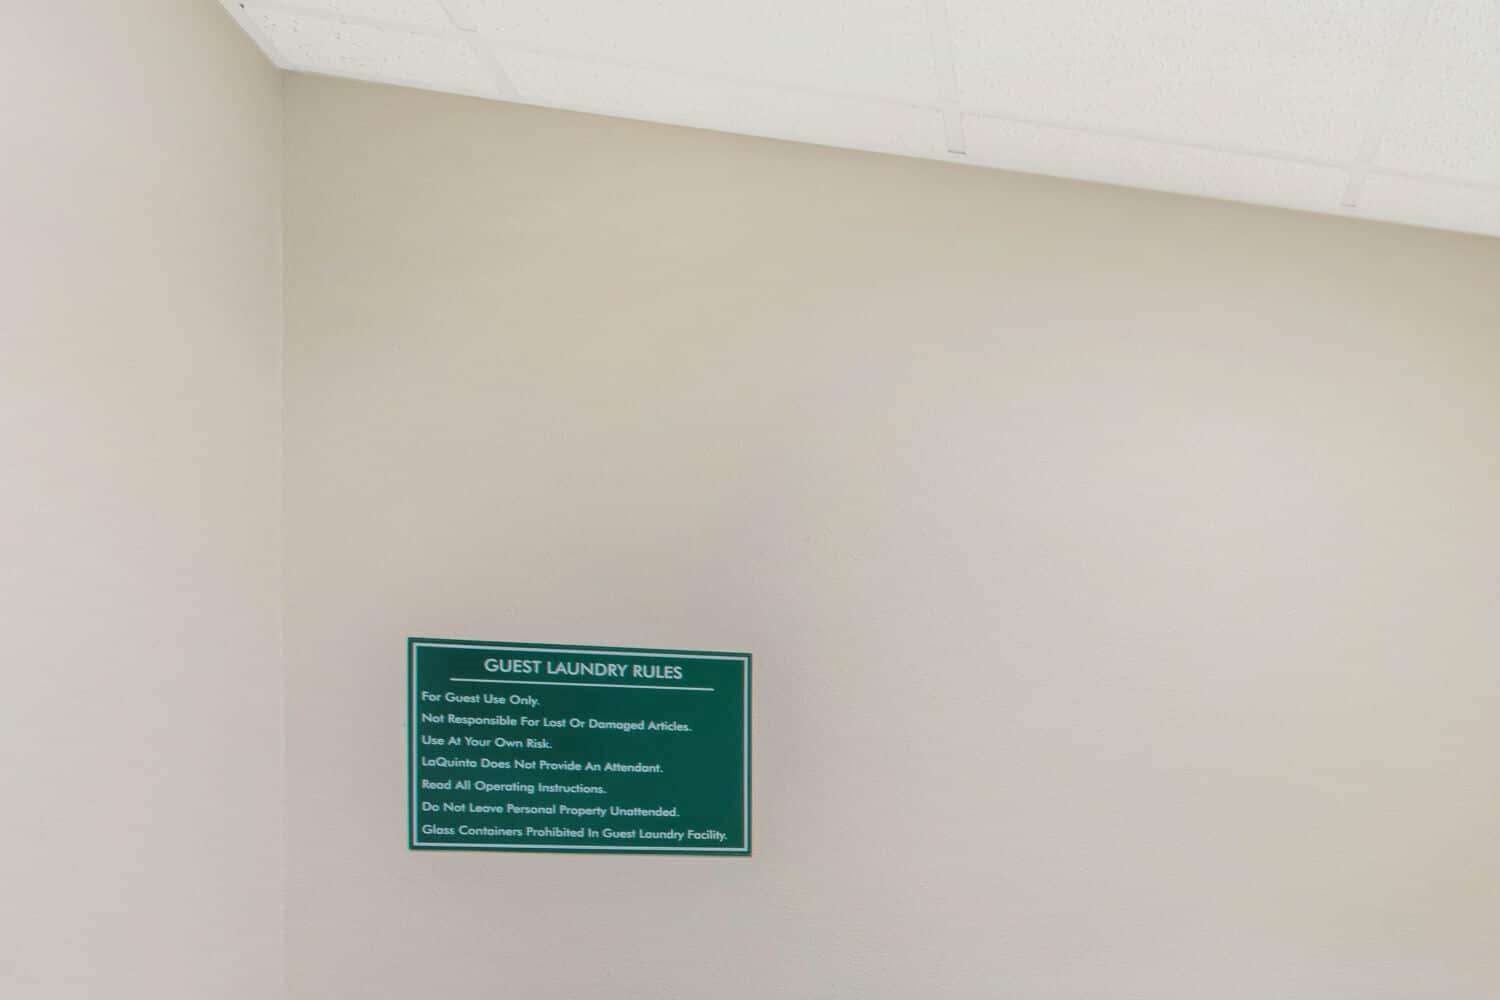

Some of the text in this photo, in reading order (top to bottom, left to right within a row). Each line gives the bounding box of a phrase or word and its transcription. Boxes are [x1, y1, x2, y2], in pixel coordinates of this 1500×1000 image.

[484, 658, 683, 680] GUEST LAUNDRY RULES
[421, 691, 540, 708] For Guest Use Only.
[421, 713, 693, 732] Not Responsible For Lost Or Damaged Articles.
[421, 735, 552, 749] Use At Your Own Risk.
[421, 757, 664, 773] LaQuinta Does Not Provide An Attendant.
[421, 780, 608, 794] Read All Operating Instructions.
[421, 802, 680, 817] Do Not Leave Personal Property Unattended.
[422, 824, 728, 842] Glass Containers Prohibited In Guest Laundry Facility.
